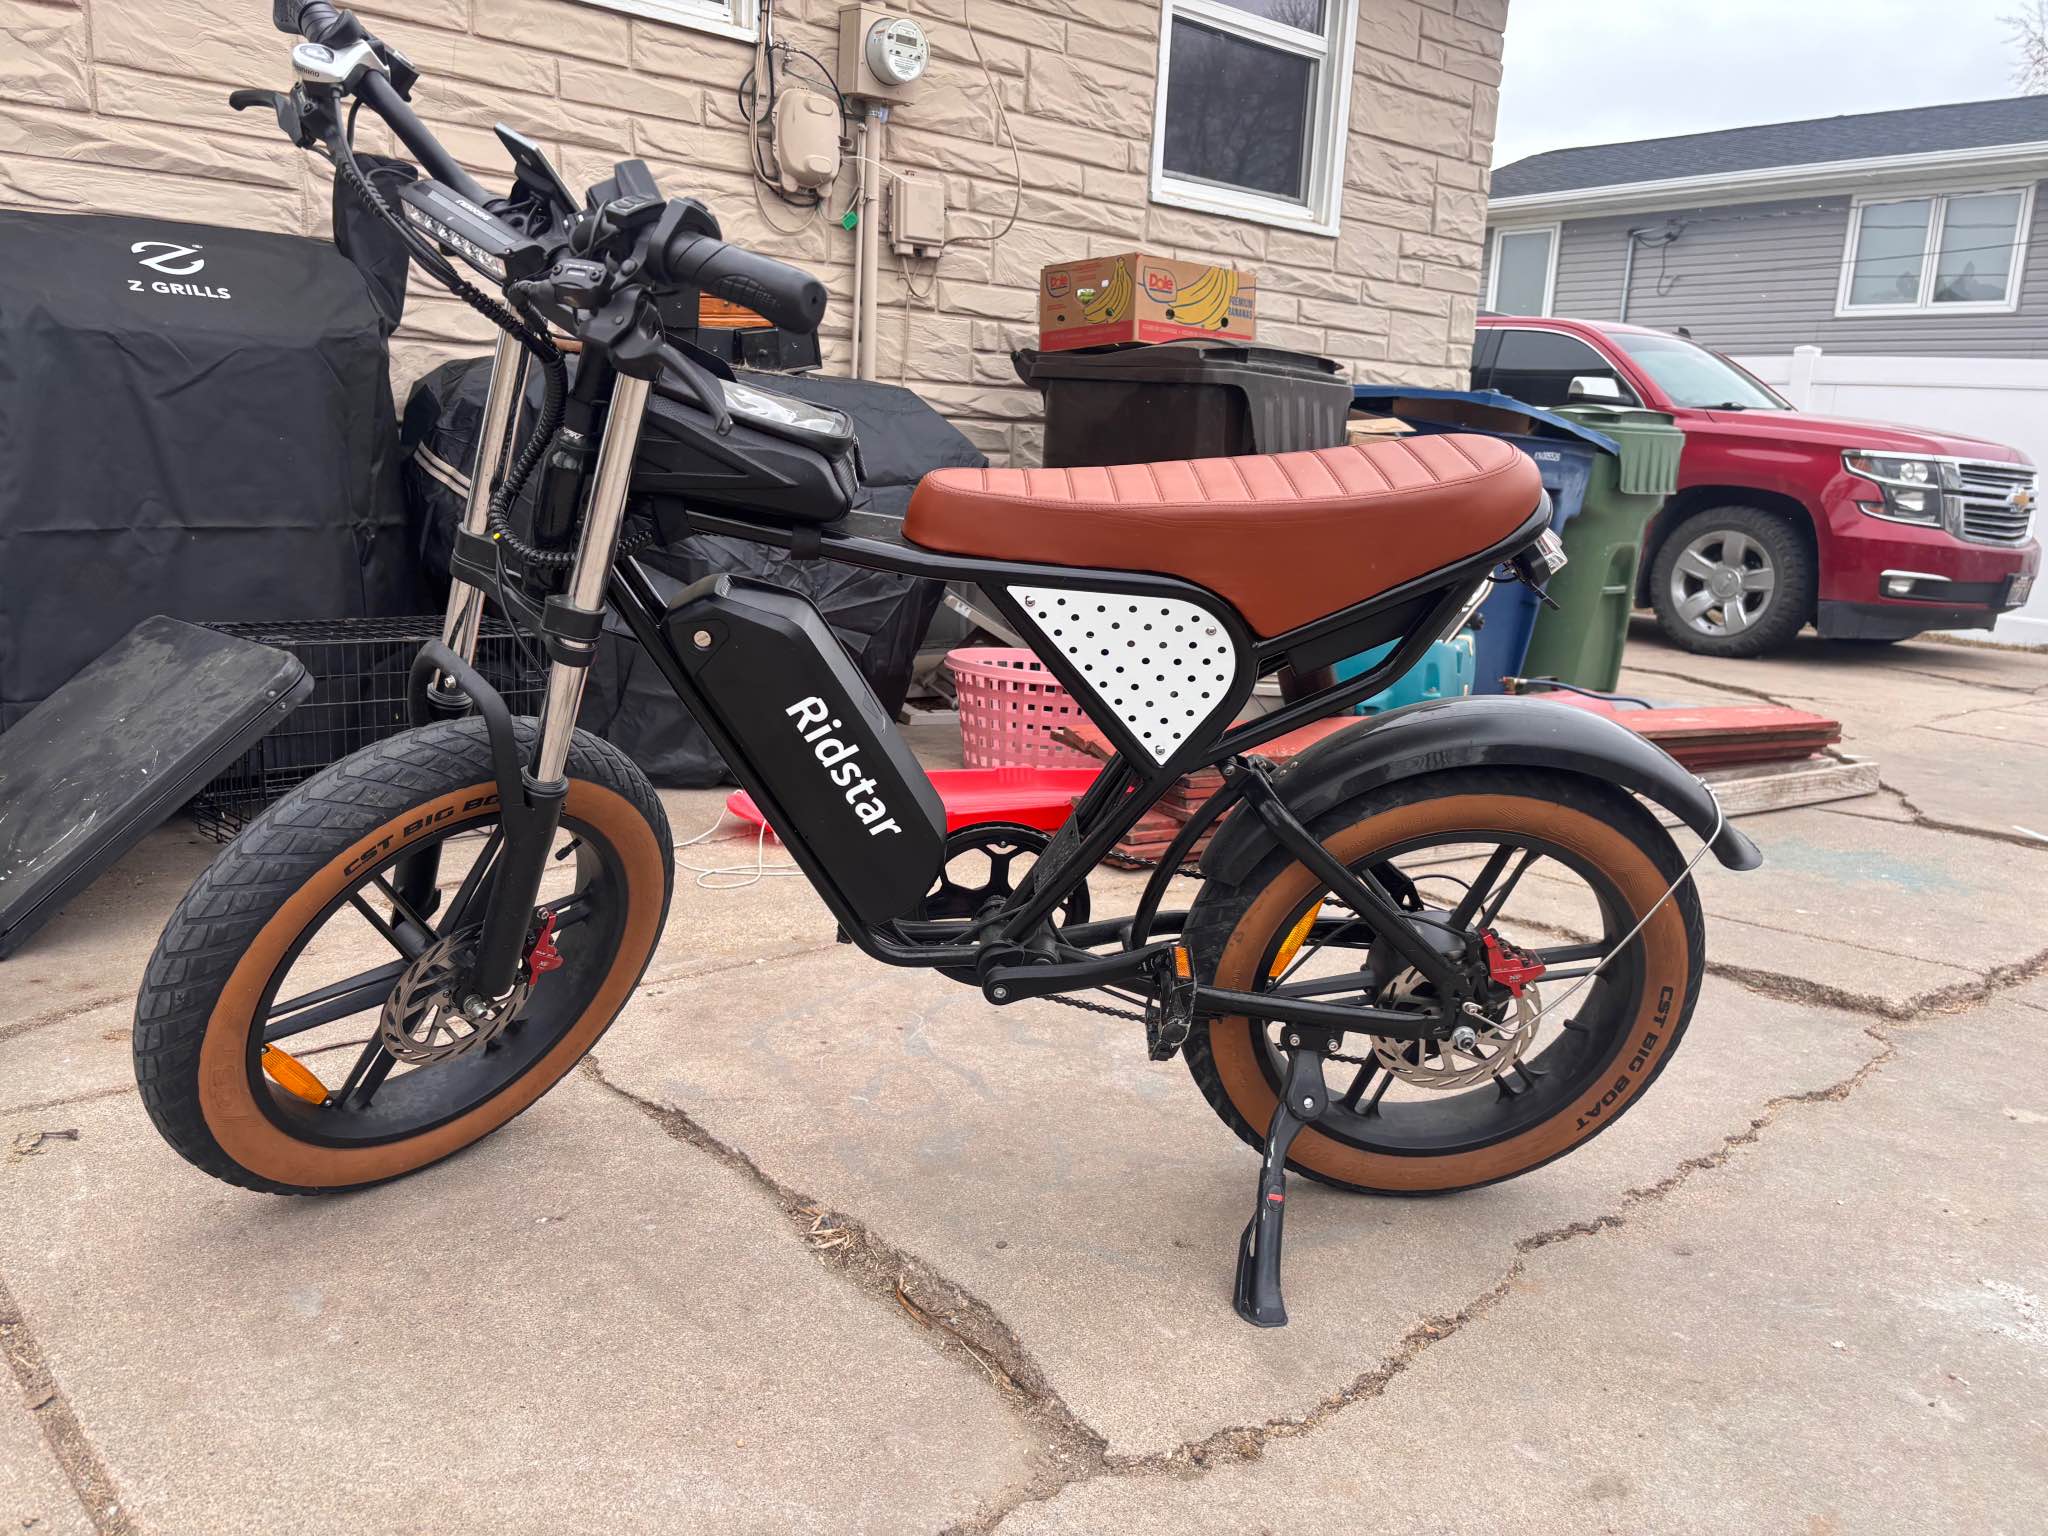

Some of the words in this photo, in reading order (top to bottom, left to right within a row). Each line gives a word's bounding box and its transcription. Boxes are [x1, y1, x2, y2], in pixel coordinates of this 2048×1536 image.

[127, 279, 145, 292] Z
[151, 281, 231, 299] GRILLS
[1149, 272, 1174, 290] Dole
[785, 696, 902, 836] Ridstar
[344, 834, 394, 877] CST
[403, 806, 455, 837] BIG
[463, 794, 499, 812] BO
[1653, 985, 1674, 1029] CST
[1628, 1031, 1659, 1073] BIG
[1575, 1074, 1631, 1132] BOAT
